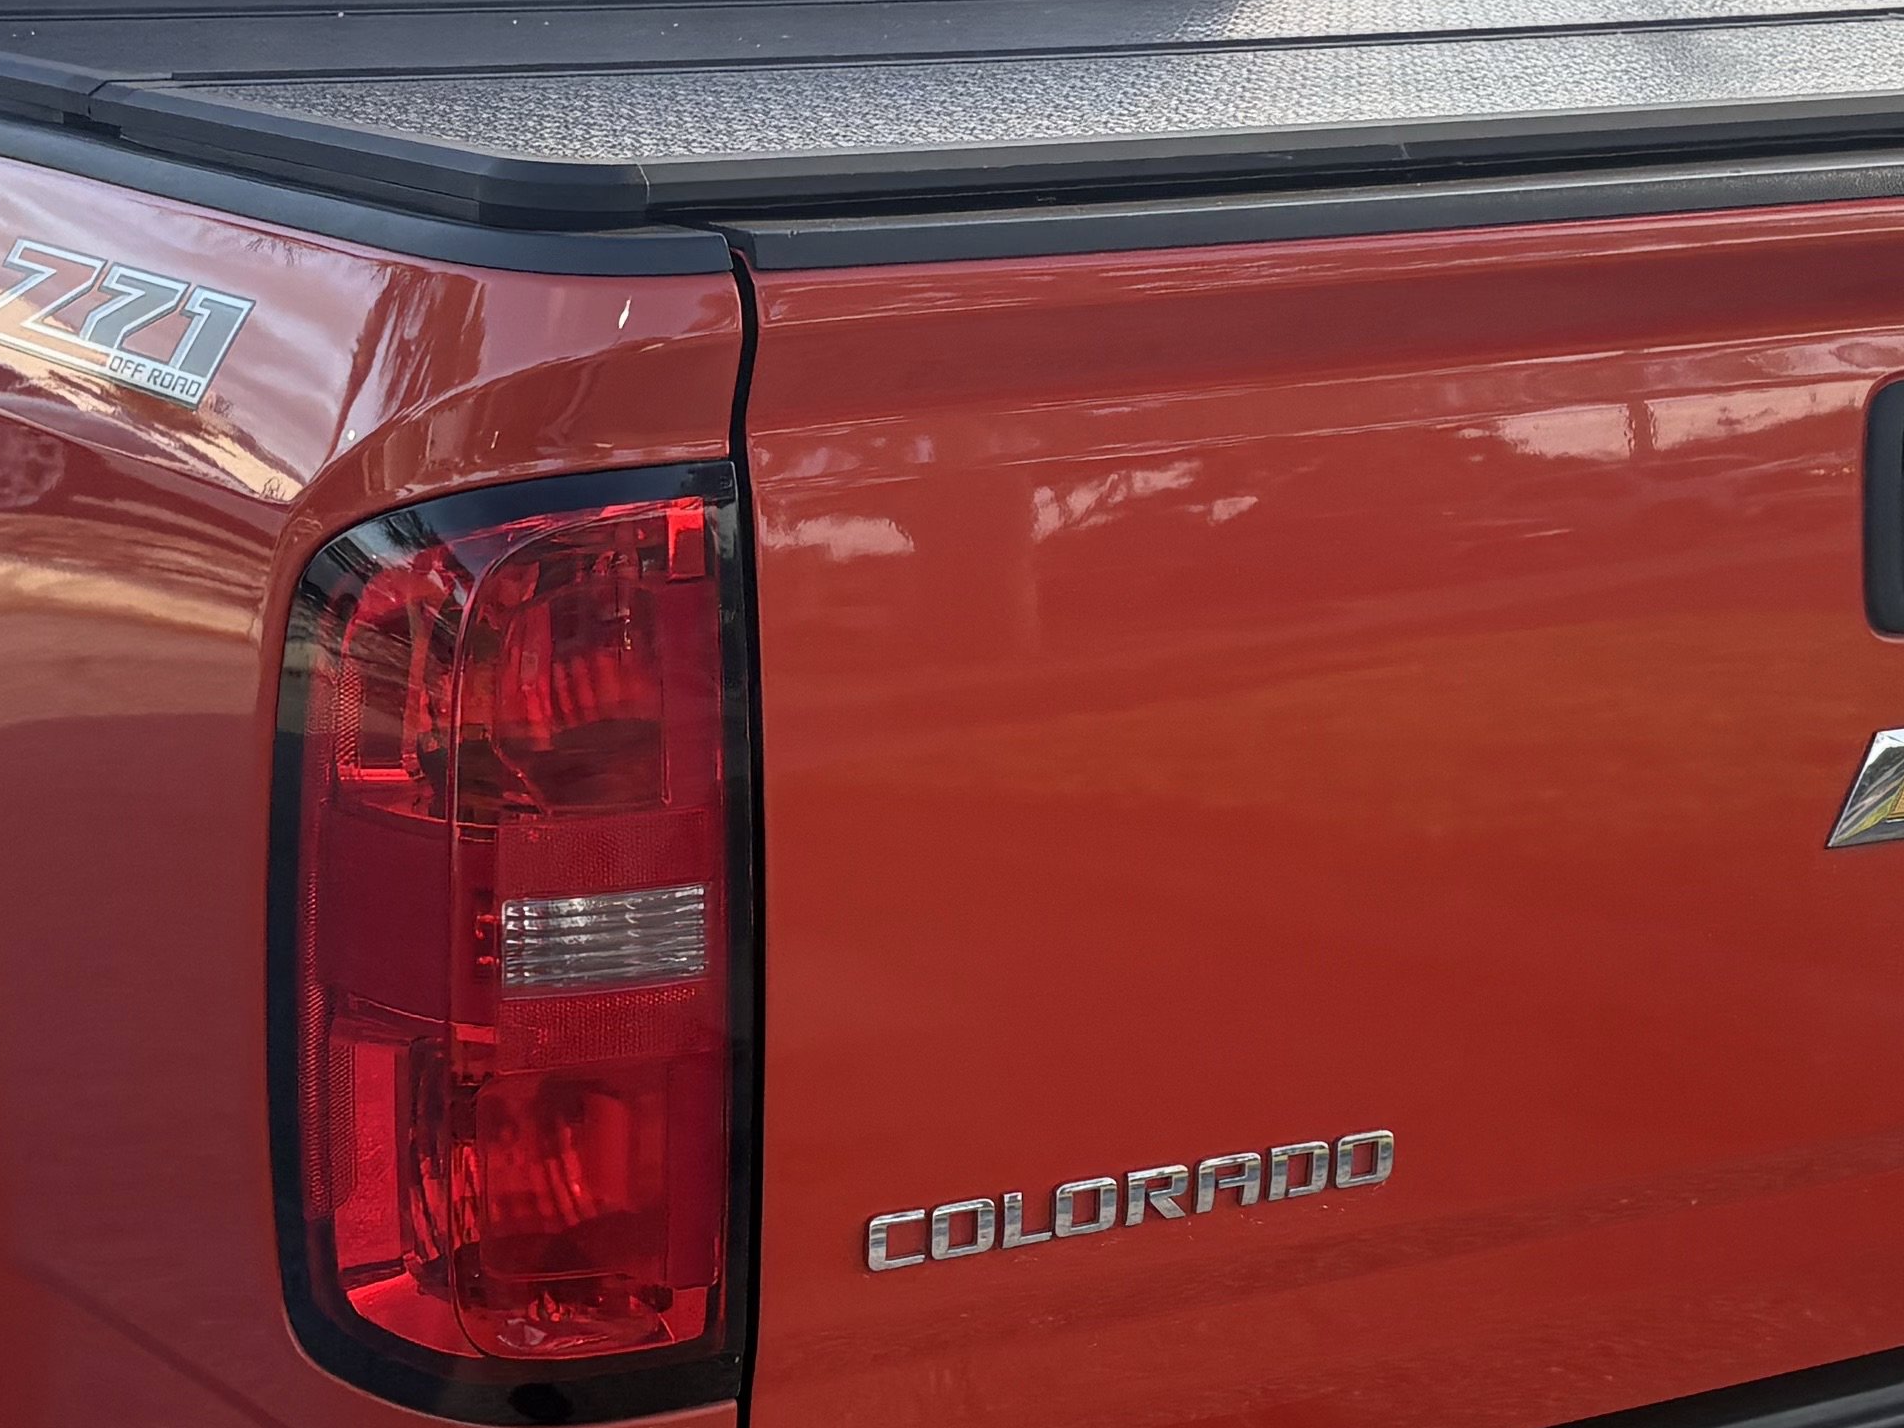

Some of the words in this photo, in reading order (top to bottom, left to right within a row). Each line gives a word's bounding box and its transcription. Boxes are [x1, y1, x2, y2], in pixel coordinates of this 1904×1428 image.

[108, 355, 147, 379] OFF
[146, 368, 202, 398] ROAD
[866, 1128, 1395, 1272] COLORADO
